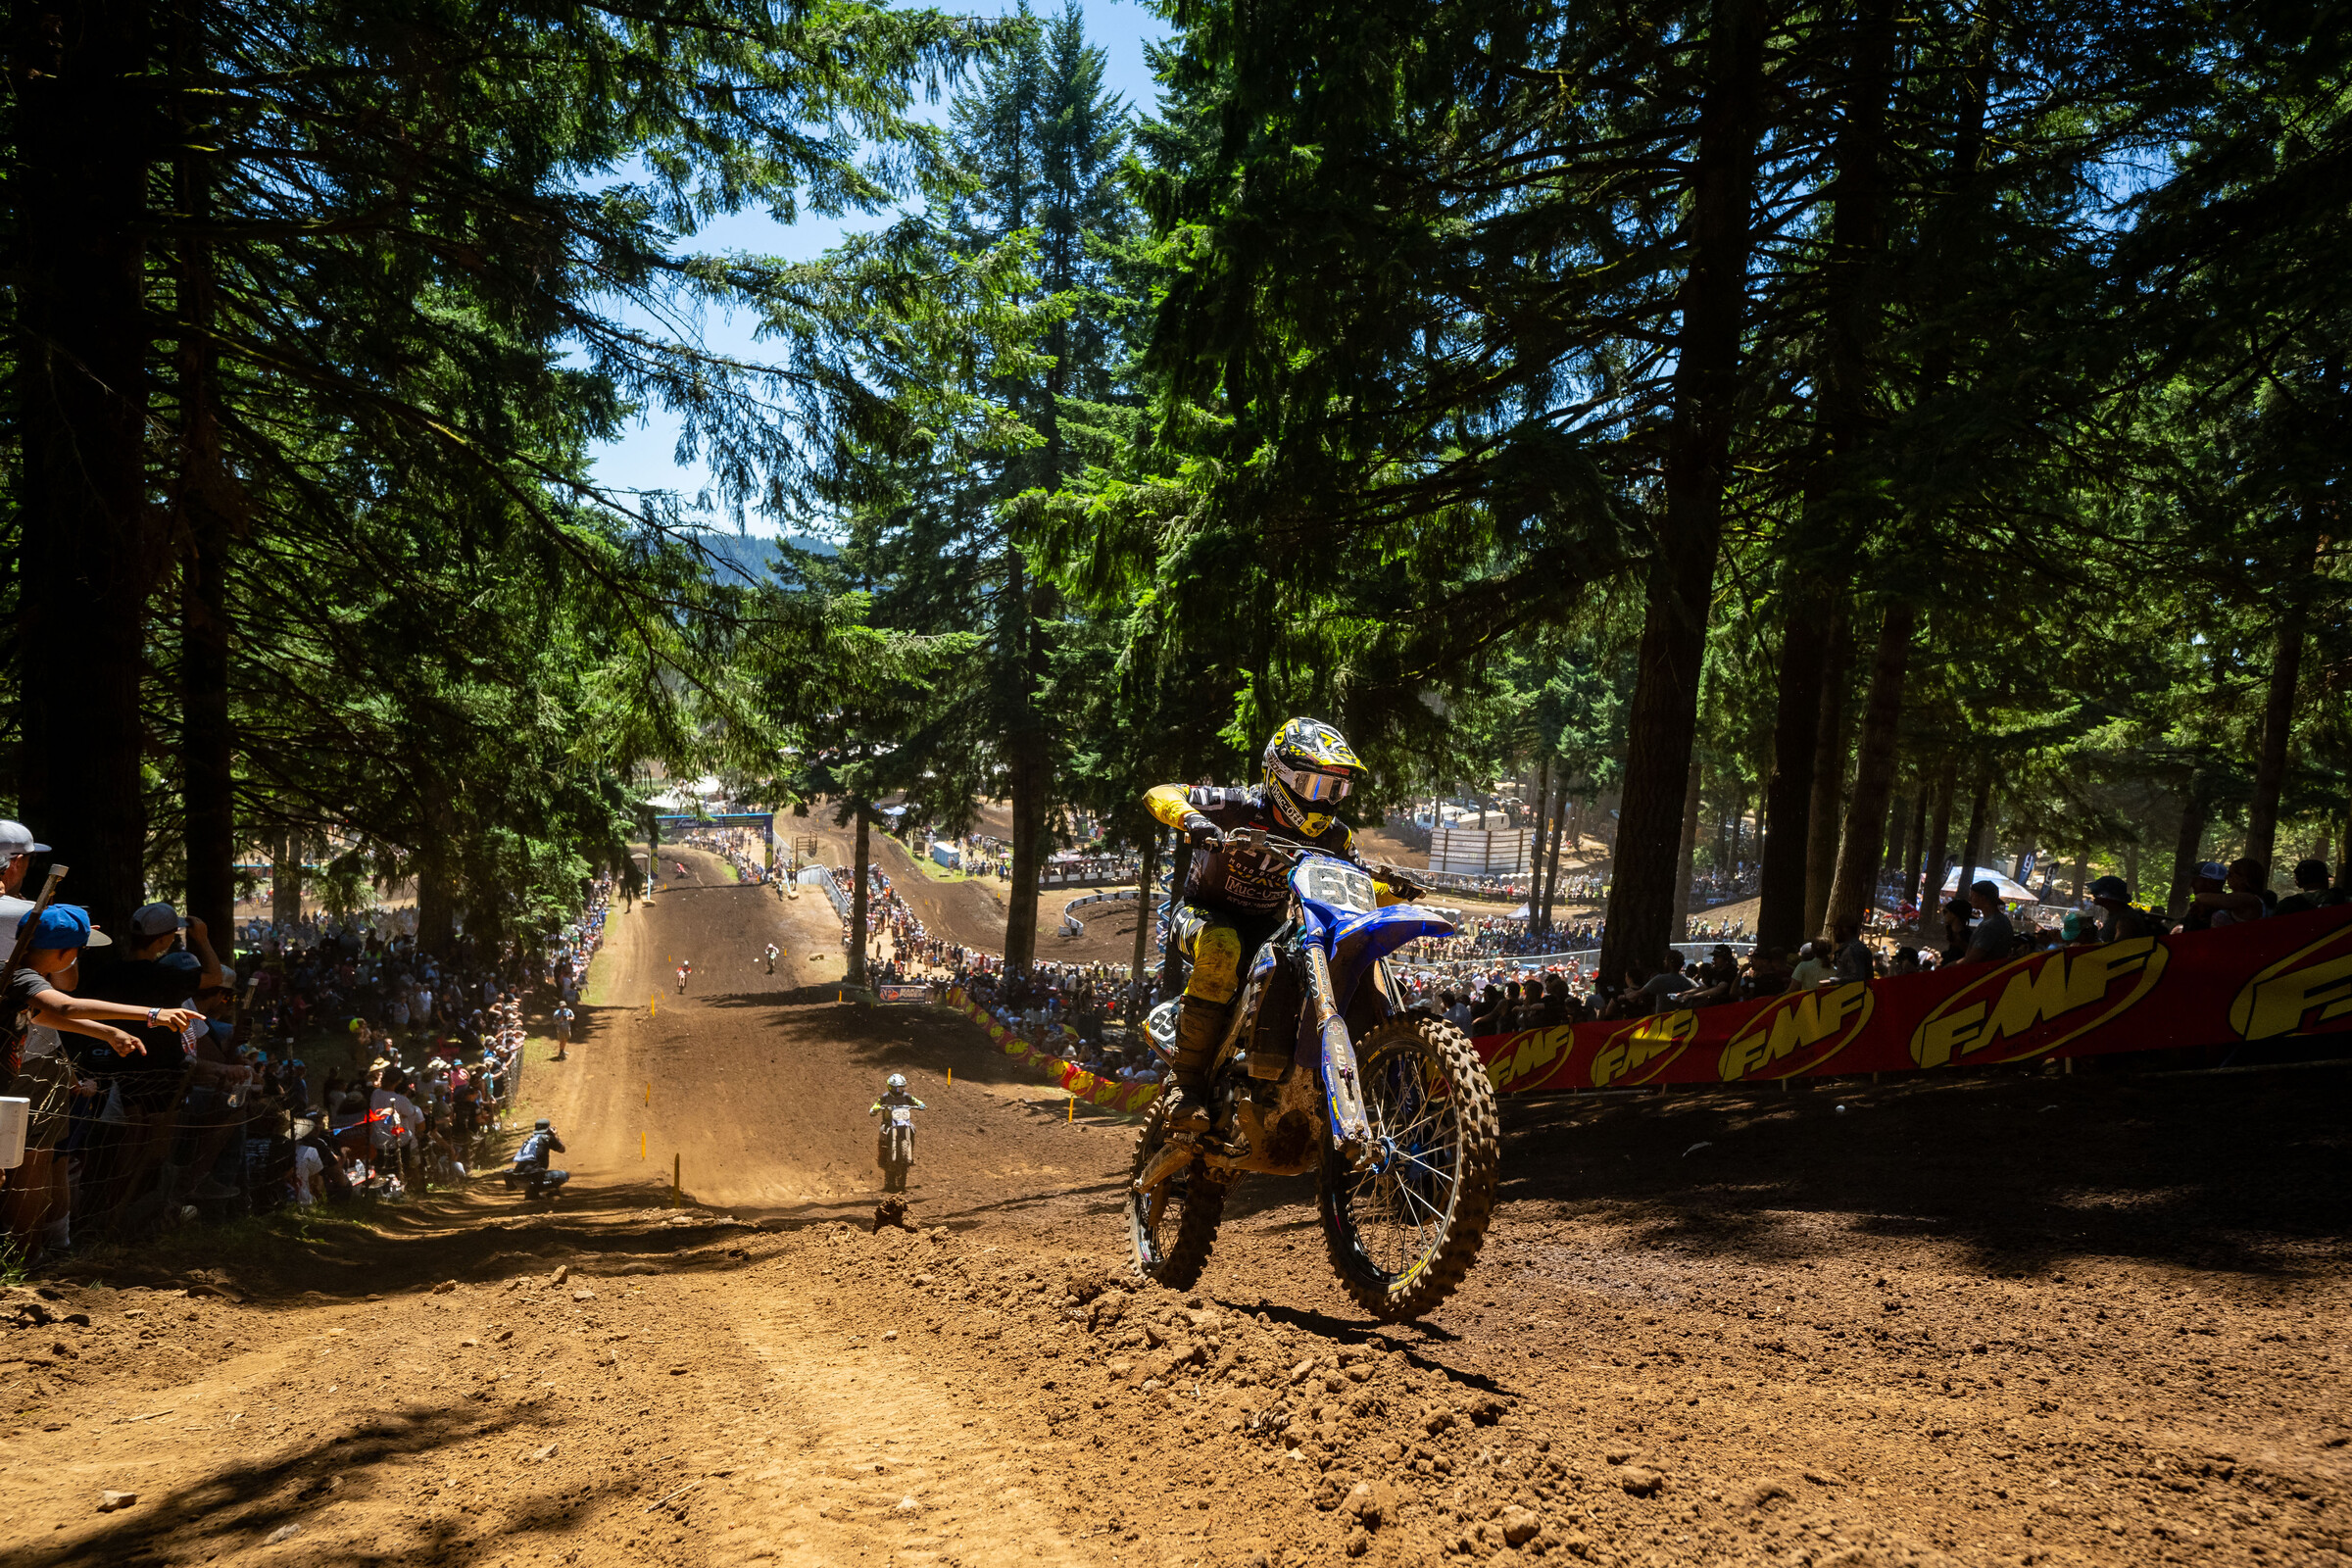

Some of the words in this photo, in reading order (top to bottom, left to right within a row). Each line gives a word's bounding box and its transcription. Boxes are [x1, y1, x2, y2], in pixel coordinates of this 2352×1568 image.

[1273, 786, 1304, 825] Muc-Off
[1229, 858, 1253, 874] MOTO
[1228, 879, 1289, 900] Muc-O
[1308, 867, 1377, 912] 69
[1921, 936, 2155, 1069] FMF
[1595, 1008, 1693, 1088] FMF
[1723, 981, 1865, 1082] FMF
[1488, 1025, 1570, 1092] FMF
[1126, 1083, 1160, 1113] FMF
